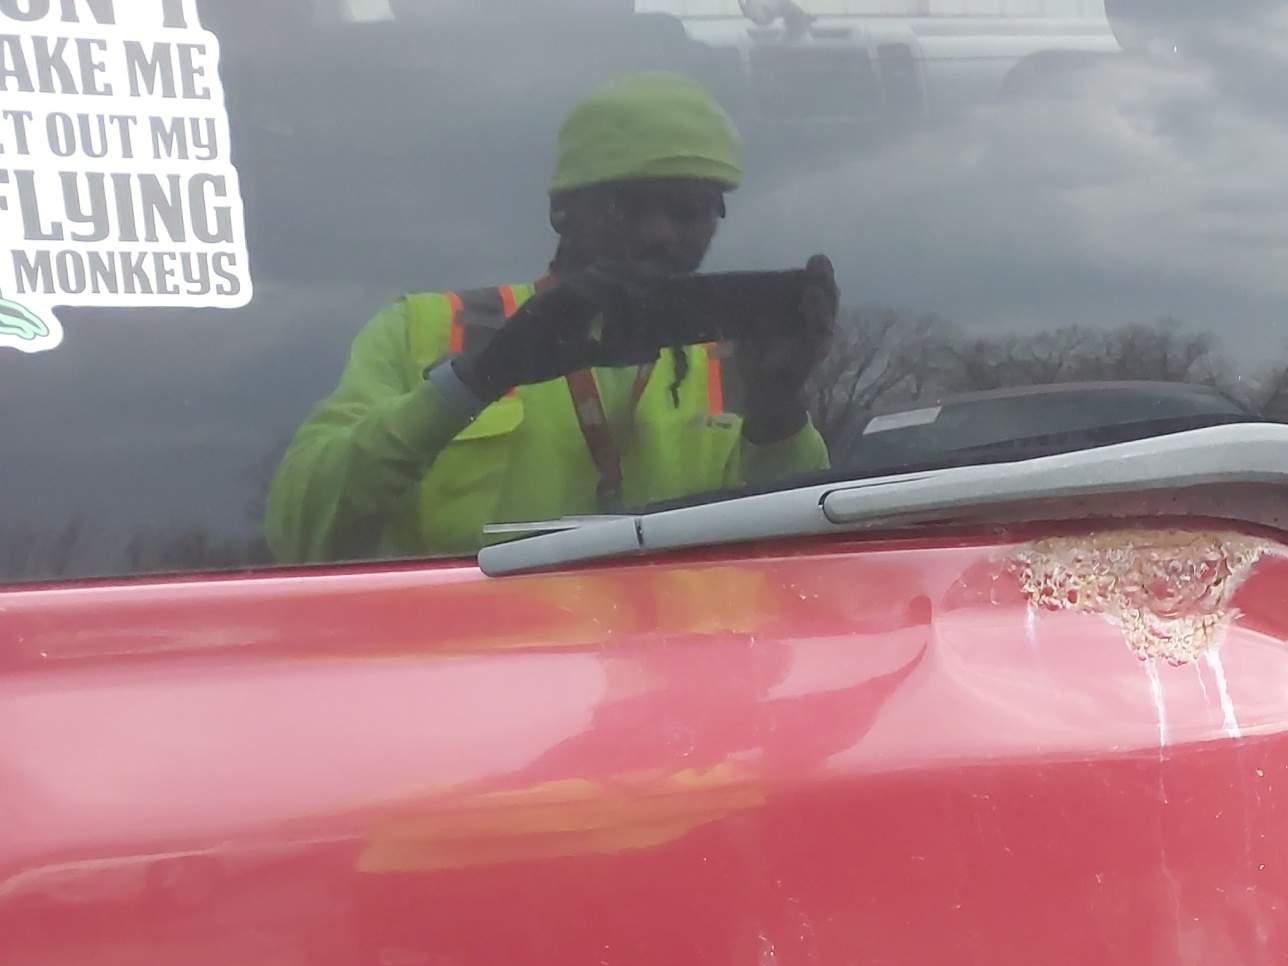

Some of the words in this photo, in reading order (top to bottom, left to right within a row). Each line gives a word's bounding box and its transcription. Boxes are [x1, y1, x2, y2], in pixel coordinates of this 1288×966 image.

[0, 34, 113, 96] AKE
[123, 40, 211, 100] ME
[46, 112, 137, 159] OUT
[149, 116, 218, 161] MY
[11, 249, 241, 296] MONKEYS
